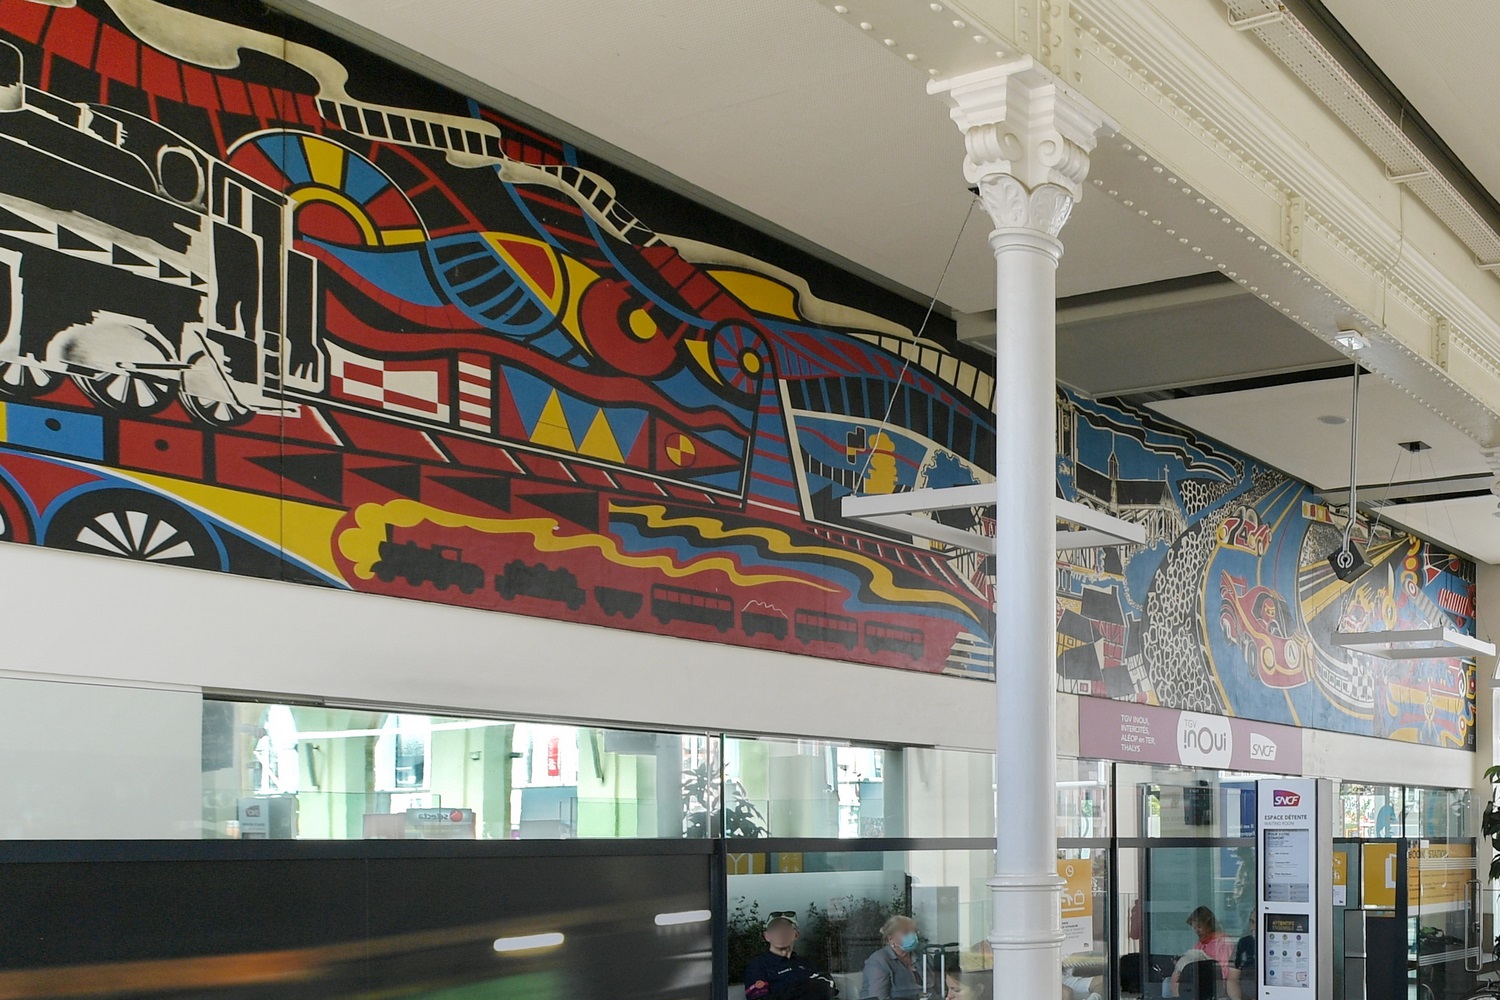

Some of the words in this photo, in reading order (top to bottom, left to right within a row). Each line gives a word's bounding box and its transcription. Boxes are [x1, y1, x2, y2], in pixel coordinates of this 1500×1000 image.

[1121, 714, 1132, 723] TGV
[1133, 717, 1149, 726] INOUI,
[1184, 719, 1197, 729] TGV
[1121, 724, 1149, 735] INTERCITÉS,
[1121, 733, 1138, 743] ALÉOP
[1121, 744, 1140, 752] THALYS
[1252, 744, 1275, 757] SNCF
[1274, 796, 1299, 805] SNCF
